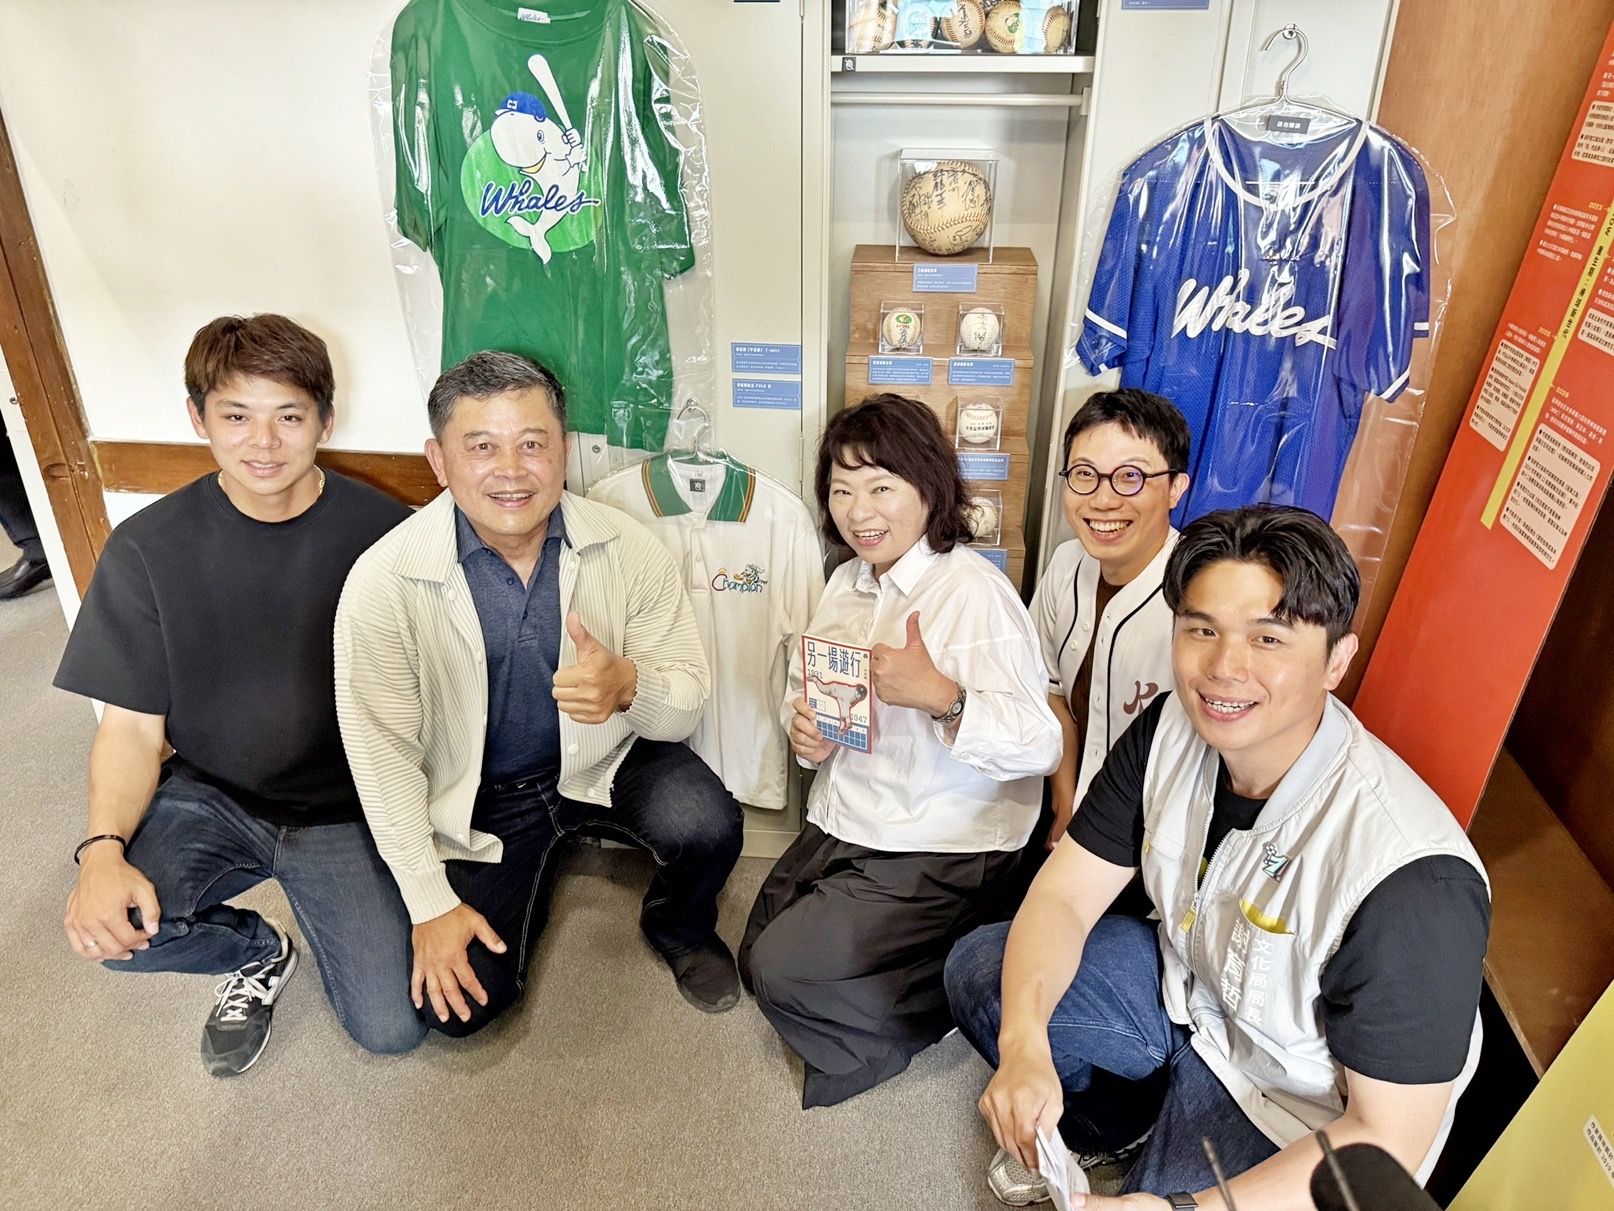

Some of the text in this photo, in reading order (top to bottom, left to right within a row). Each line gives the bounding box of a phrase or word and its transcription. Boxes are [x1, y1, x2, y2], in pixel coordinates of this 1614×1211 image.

[480, 177, 600, 218] Whales
[1171, 268, 1337, 350] Whales
[712, 573, 763, 593] Champion
[807, 641, 861, 678] 另一場遊行
[1245, 938, 1274, 1027] 文化局局長
